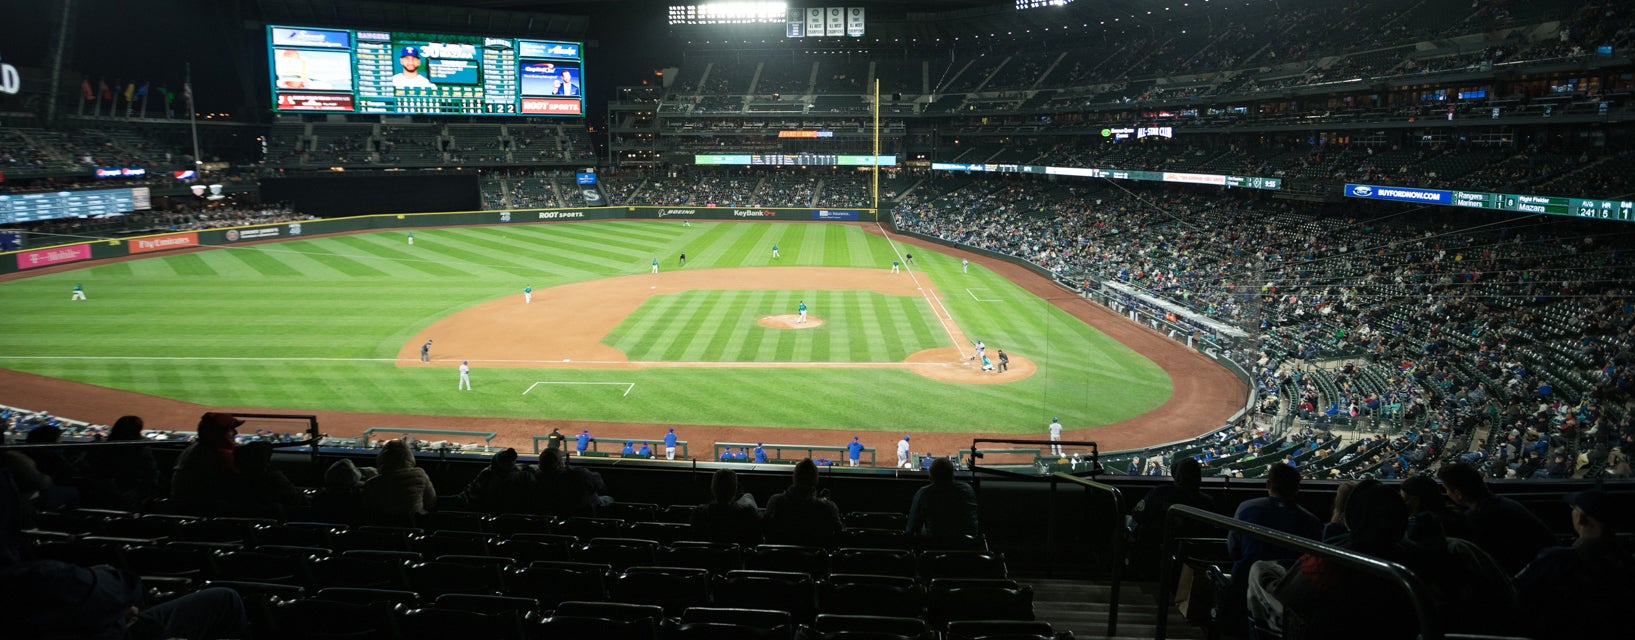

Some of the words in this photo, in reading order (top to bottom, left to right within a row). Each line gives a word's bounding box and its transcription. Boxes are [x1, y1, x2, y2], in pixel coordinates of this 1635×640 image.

[487, 104, 493, 113] 1
[497, 104, 504, 113] 2
[507, 104, 514, 113] 2
[523, 101, 548, 111] ROOT
[1137, 127, 1159, 139] ALL-STAR
[1159, 127, 1172, 138] CLUB
[1377, 189, 1440, 200] BUYFORDNOW.COM
[1458, 191, 1483, 200] Rangers
[1519, 195, 1532, 203] Right
[1458, 199, 1483, 208] Mariners
[1508, 199, 1513, 207] 8
[1582, 200, 1594, 208] AVG
[1620, 201, 1633, 209] Ball
[1519, 203, 1545, 213] Mazara
[1602, 209, 1609, 218] 5
[1622, 209, 1628, 219] 1
[138, 240, 156, 249] Fly
